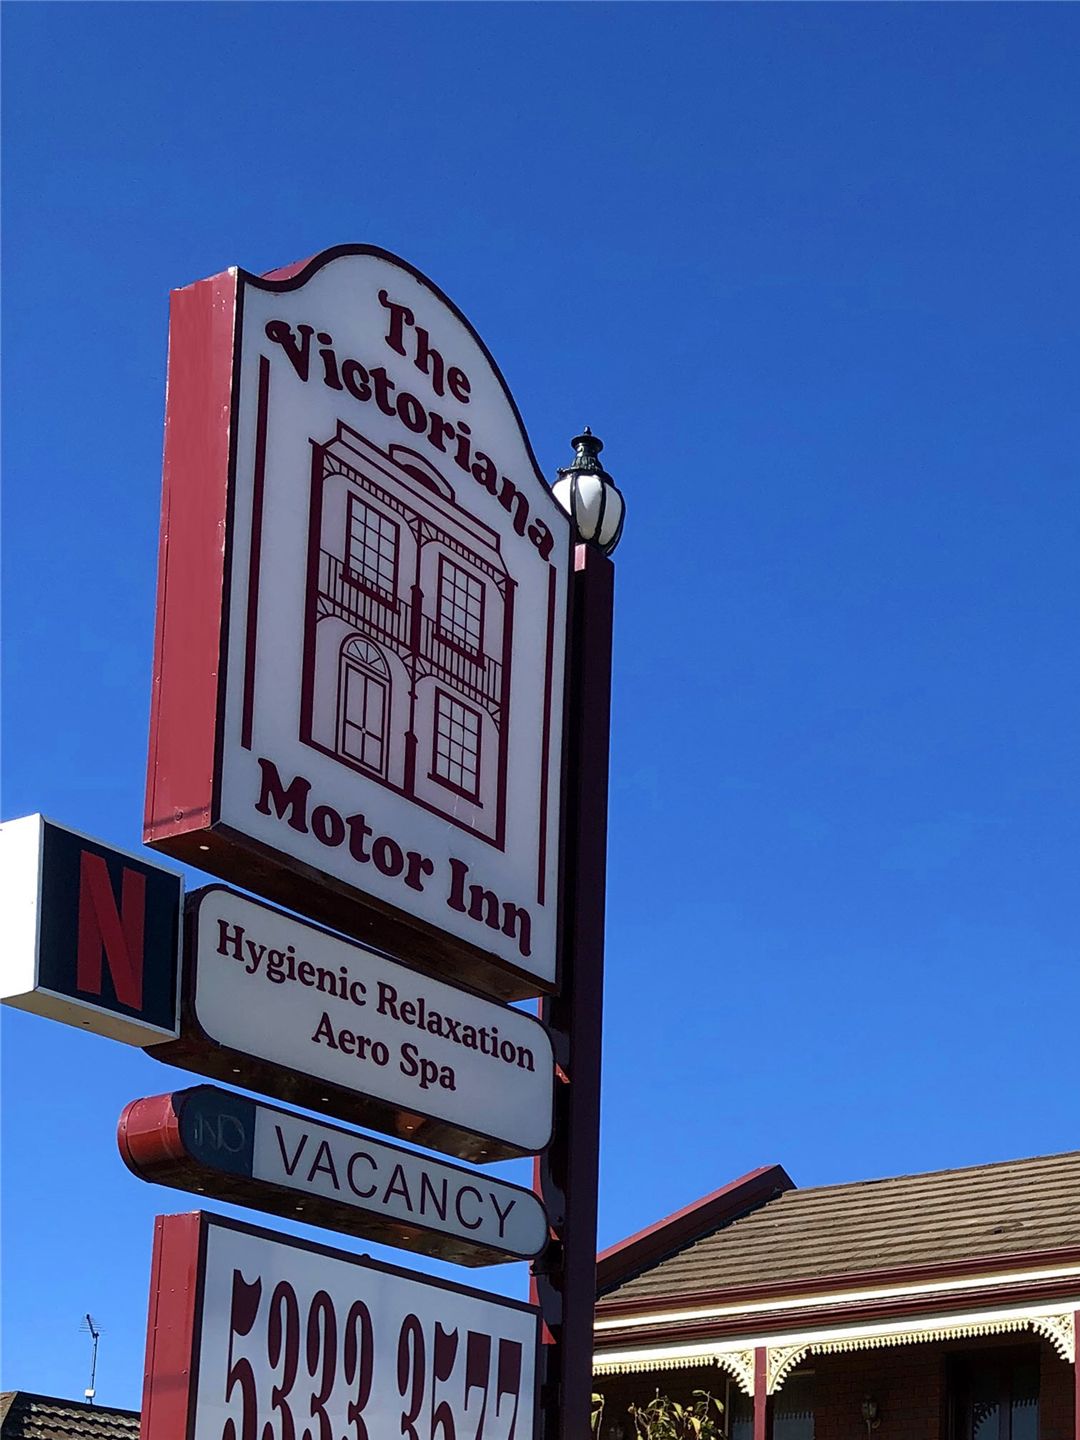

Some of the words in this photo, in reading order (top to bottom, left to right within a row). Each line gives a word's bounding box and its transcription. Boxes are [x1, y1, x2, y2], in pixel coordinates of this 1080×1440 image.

[377, 289, 472, 405] The
[265, 319, 555, 563] Victoriana
[77, 851, 146, 1012] N
[254, 757, 436, 893] Motor
[446, 857, 532, 958] Inn
[215, 918, 367, 1007] Hygienic
[375, 980, 536, 1073] Relaxation
[310, 1011, 390, 1067] Aero
[399, 1042, 457, 1092] Spa
[274, 1124, 517, 1242] VACANCY
